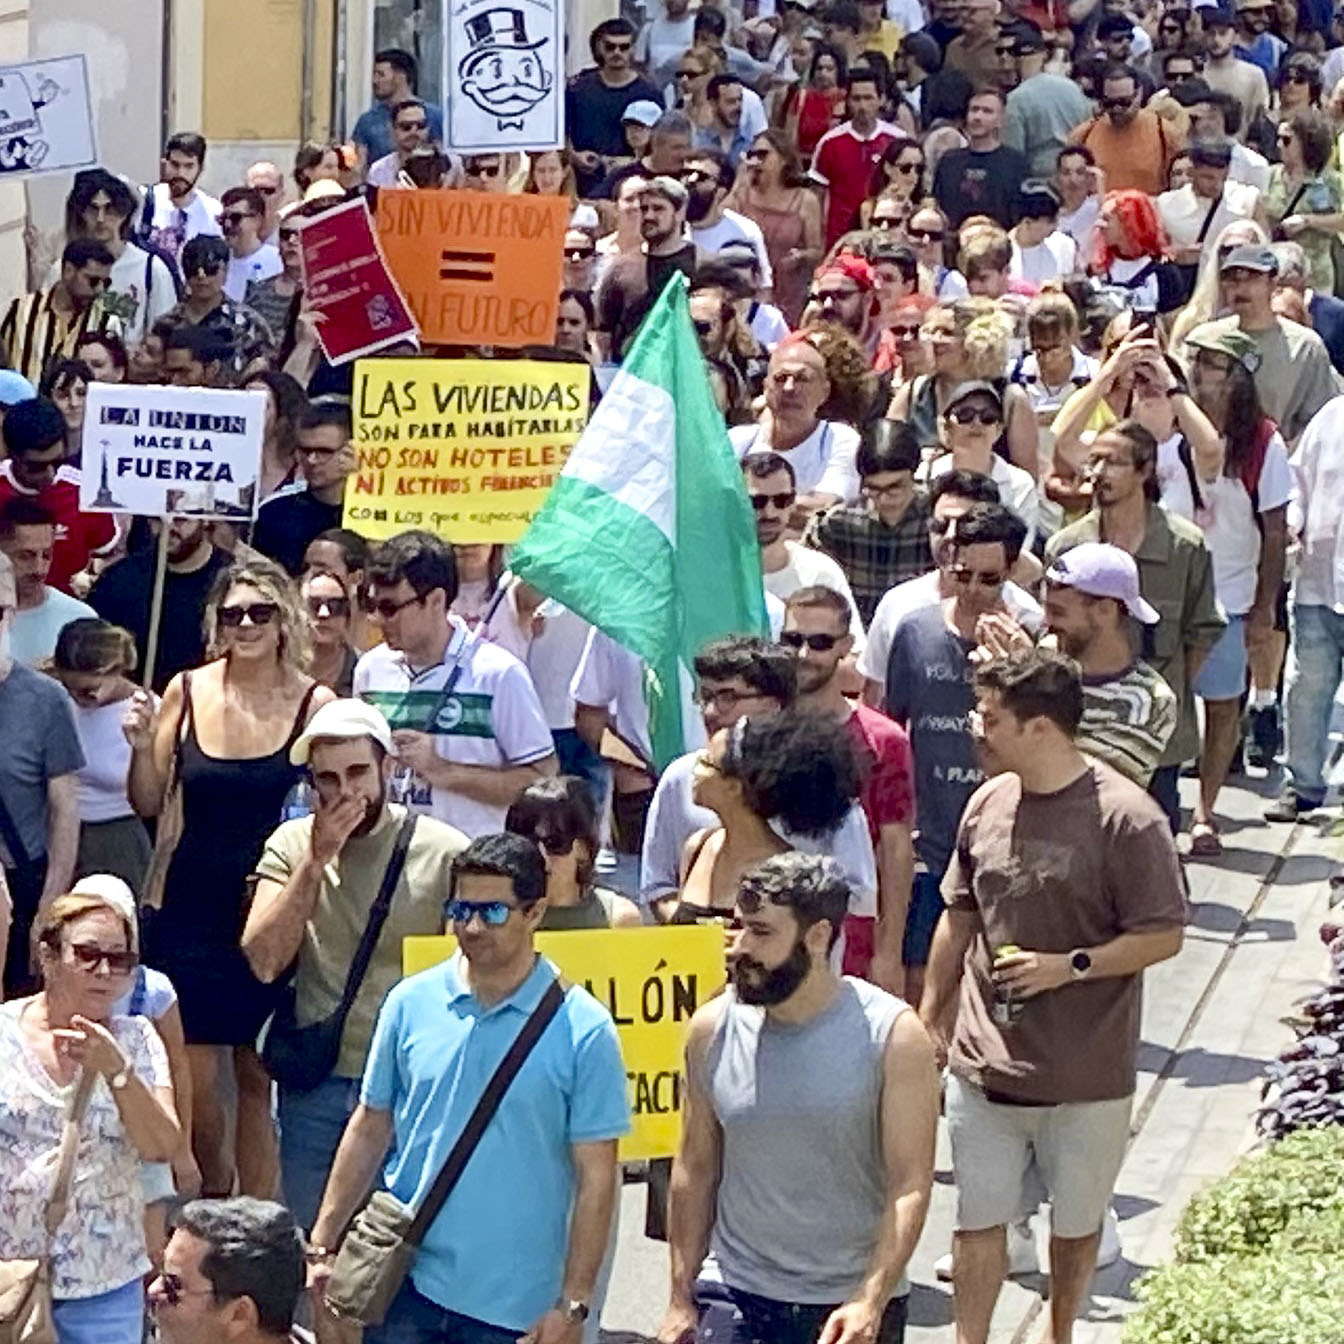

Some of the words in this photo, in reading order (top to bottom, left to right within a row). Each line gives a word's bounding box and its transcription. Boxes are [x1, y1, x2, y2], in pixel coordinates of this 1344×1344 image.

[378, 197, 424, 238] SIN
[437, 201, 554, 240] VIVIENDA
[440, 290, 550, 338] FUTURO
[360, 373, 417, 420] LAS
[432, 381, 581, 414] VIVIENDAS
[134, 433, 185, 450] HACE
[188, 437, 213, 453] LA
[359, 422, 399, 442] SON
[409, 421, 456, 440] PARA
[116, 456, 234, 484] FUERZA
[357, 446, 391, 470] NO
[396, 446, 439, 469] SON
[450, 445, 574, 469] HOTELES
[354, 472, 385, 497] NI
